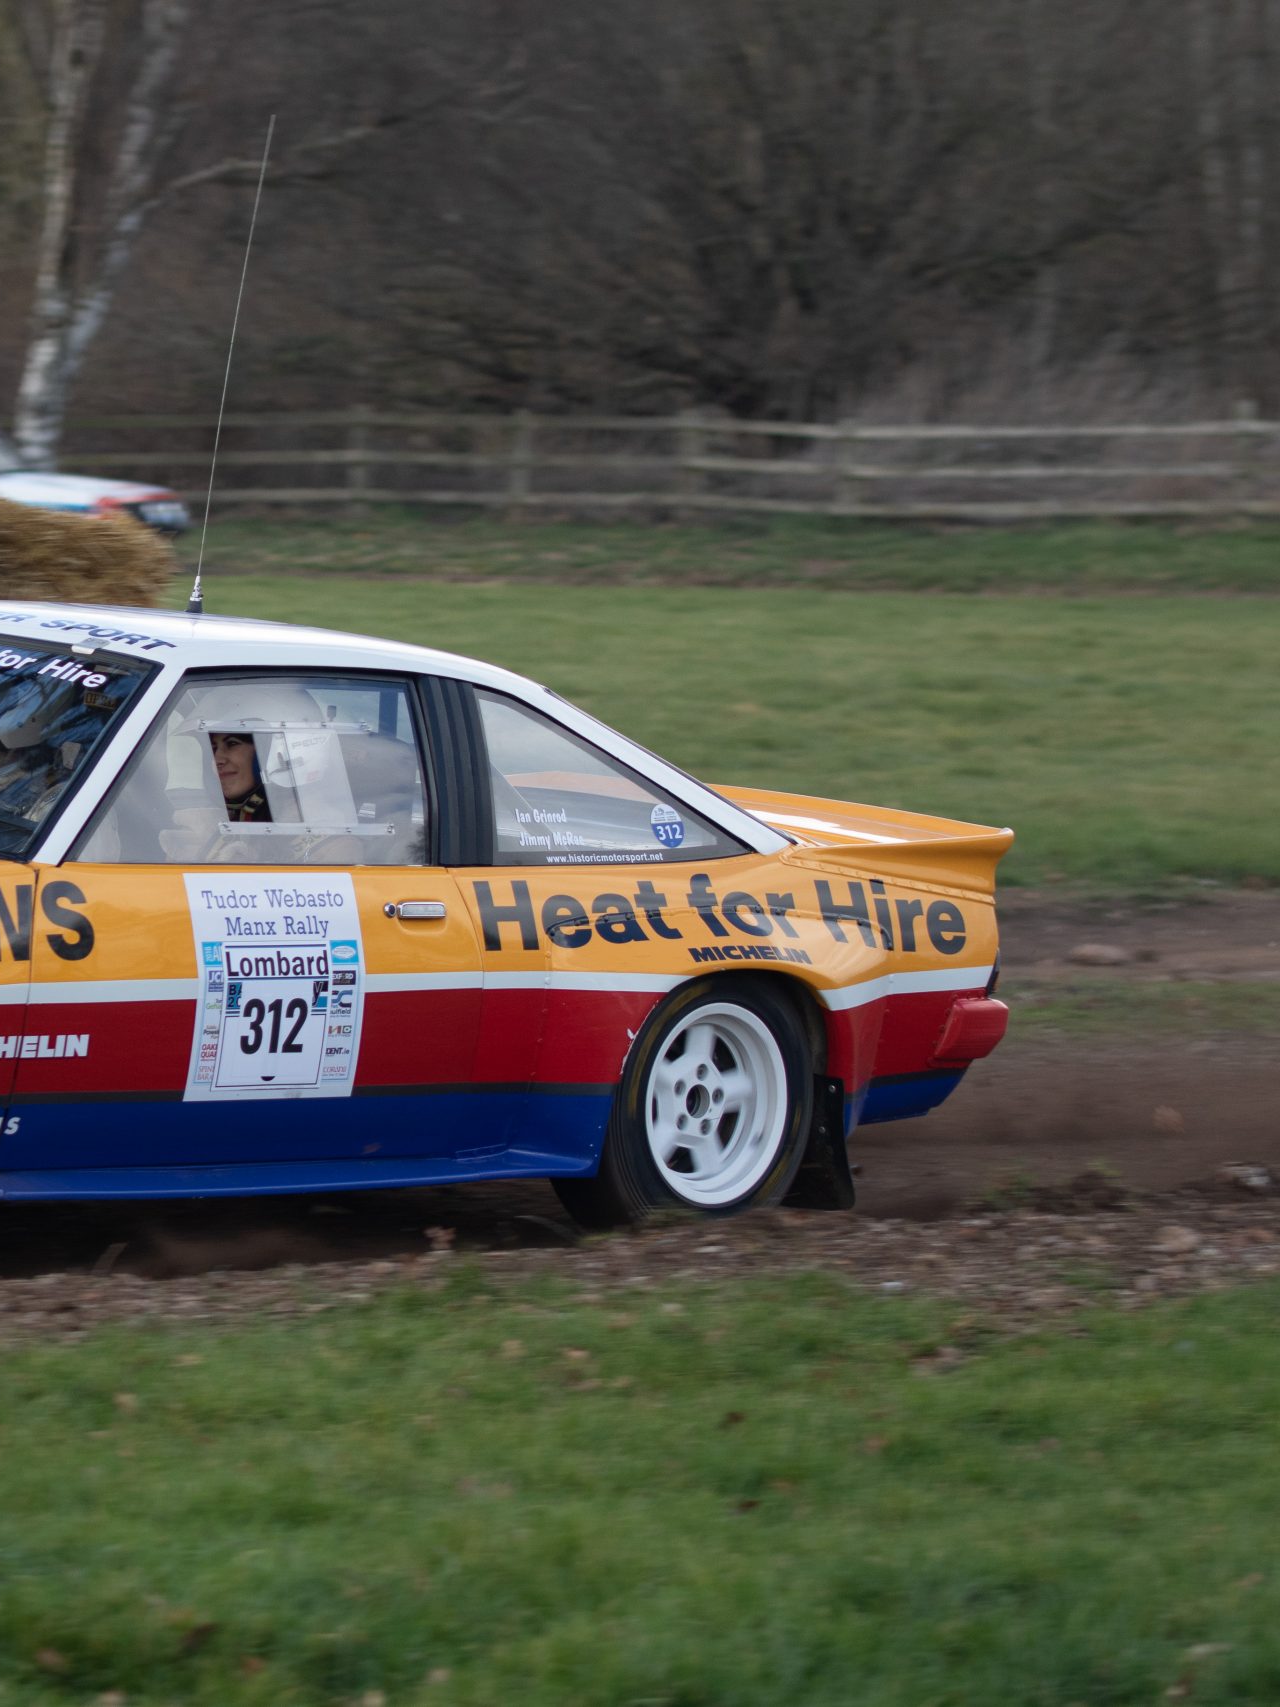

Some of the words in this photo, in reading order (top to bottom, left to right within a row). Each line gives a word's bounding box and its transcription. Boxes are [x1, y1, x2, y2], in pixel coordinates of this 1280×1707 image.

[40, 619, 177, 650] SPORT
[38, 658, 107, 688] Hire
[515, 808, 531, 823] Ian
[533, 808, 567, 823] Grinrod
[520, 831, 551, 850] Jimmy
[553, 831, 586, 847] McRae
[656, 823, 683, 841] 312
[546, 853, 663, 863] www.historicmotorsport.net
[201, 890, 257, 909] Tudor
[264, 889, 344, 908] Webasto
[473, 880, 682, 951] Heat
[687, 874, 800, 938] for
[813, 879, 966, 955] Hire
[225, 917, 277, 936] Manx
[283, 916, 329, 938] Rally
[225, 950, 329, 977] Lombard
[689, 947, 812, 965] MICHELIN
[240, 997, 308, 1055] 312
